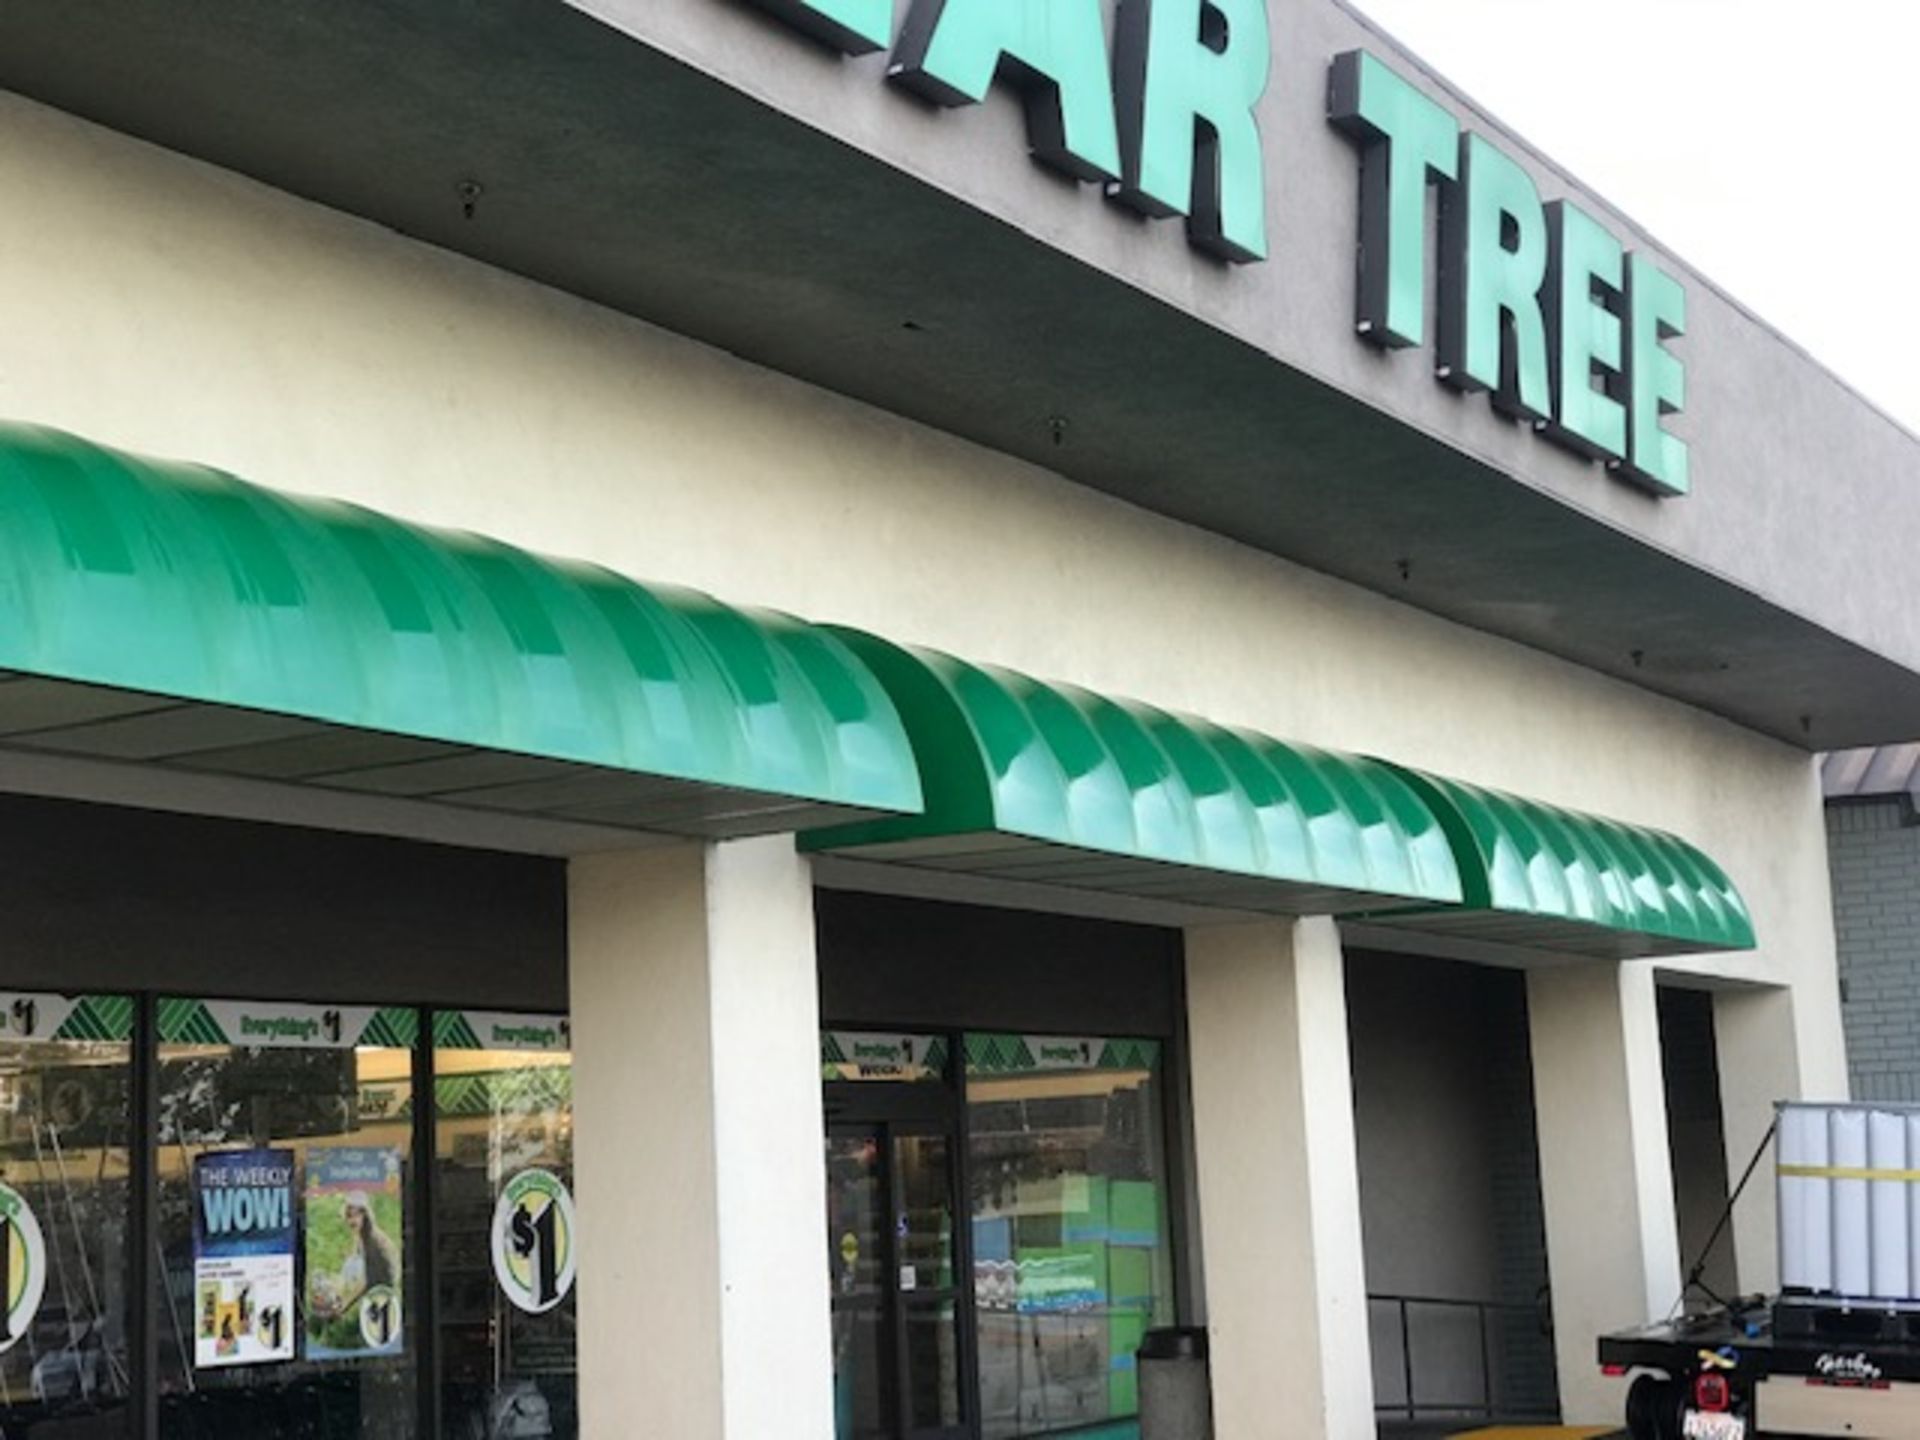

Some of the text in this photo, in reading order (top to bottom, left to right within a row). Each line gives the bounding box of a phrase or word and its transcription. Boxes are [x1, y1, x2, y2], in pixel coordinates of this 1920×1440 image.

[1328, 48, 1690, 497] TREE
[322, 1009, 342, 1043] $1
[201, 1166, 292, 1187] THE WEEKLY
[201, 1187, 290, 1234] WOW!
[512, 1197, 559, 1306] $1
